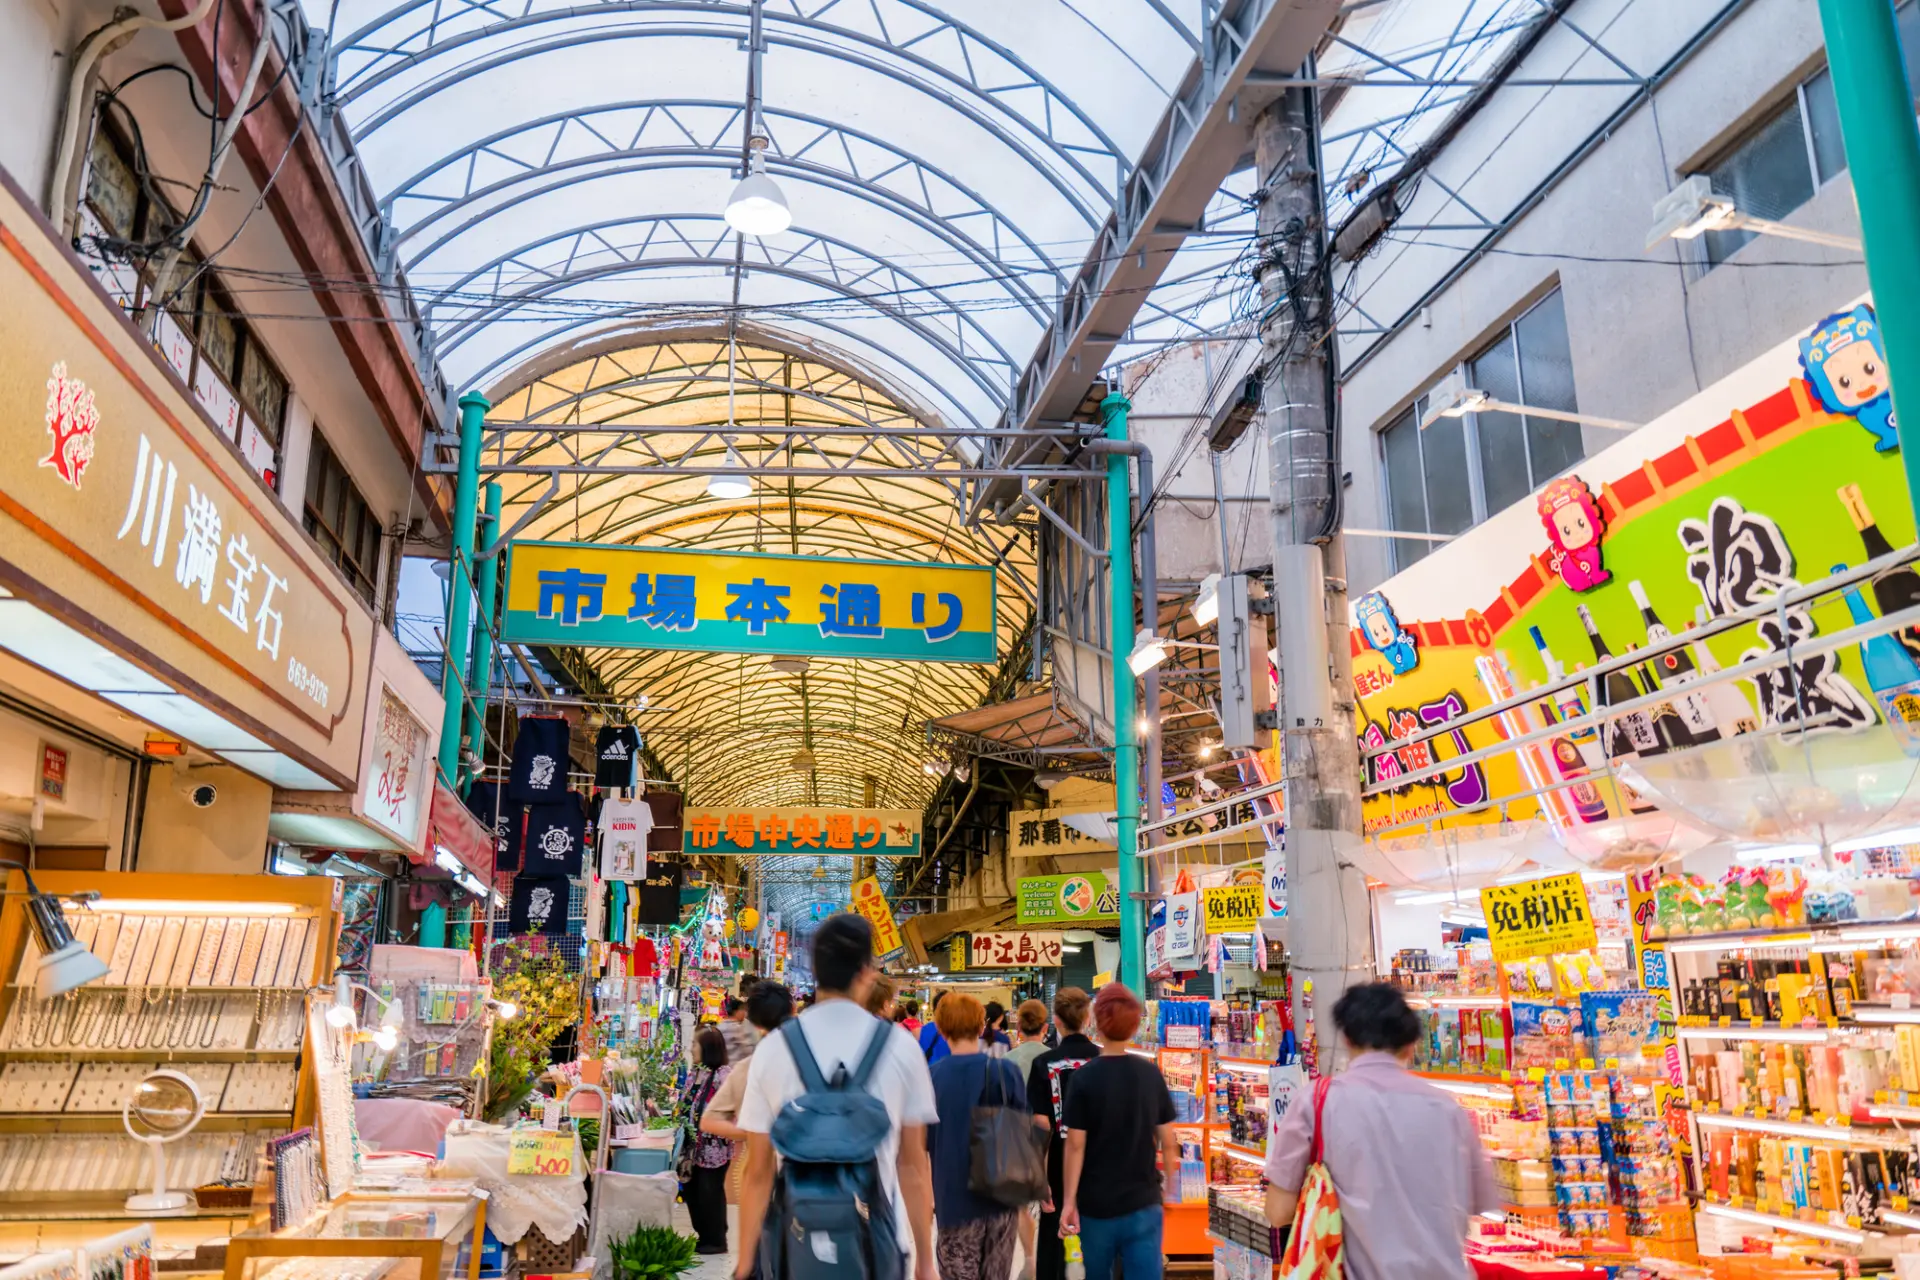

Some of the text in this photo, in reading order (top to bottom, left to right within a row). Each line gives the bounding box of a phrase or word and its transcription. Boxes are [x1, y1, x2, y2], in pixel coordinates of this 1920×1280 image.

[117, 432, 288, 661] 川満宝石
[537, 568, 963, 642] 市場本通り
[1399, 801, 1448, 825] YOKOCHO
[691, 813, 882, 850] 市場中央通り
[1019, 818, 1098, 846] 那覇市
[1024, 891, 1056, 899] welcome
[1485, 876, 1577, 899] TAX FREE
[1096, 893, 1120, 913] 公
[1208, 894, 1261, 919] 免税店
[1491, 889, 1584, 935] 免税店
[973, 932, 1061, 966] 伊江島や
